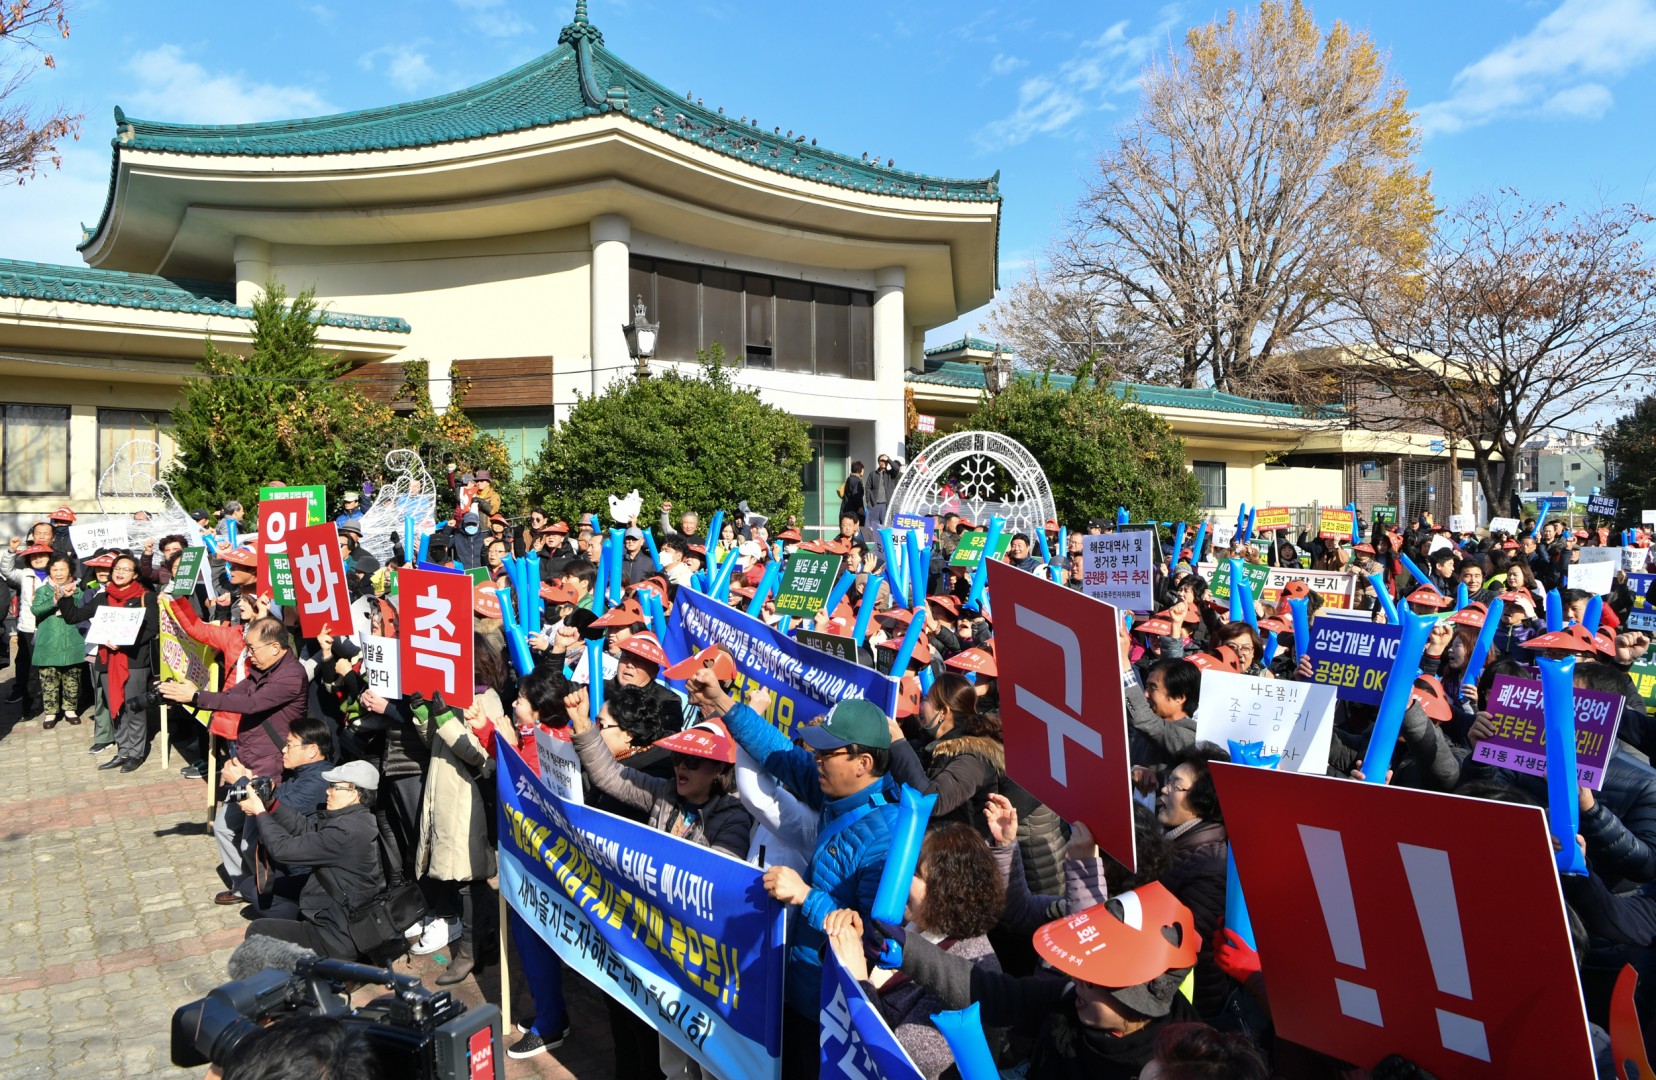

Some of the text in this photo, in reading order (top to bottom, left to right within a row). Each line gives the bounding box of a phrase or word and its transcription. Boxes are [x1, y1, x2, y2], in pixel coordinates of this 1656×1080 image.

[1090, 538, 1142, 554] 해운대역사 및
[1094, 554, 1138, 568] 정거장 부지
[794, 558, 829, 574] 빌딩 숲 속
[1084, 570, 1149, 586] 공원화 적극 추진
[295, 543, 339, 622] 화
[791, 576, 822, 592] 주민들의
[1314, 577, 1338, 590] 부지
[410, 585, 462, 694] 촉
[1316, 628, 1400, 660] 상업개발 NO
[1314, 660, 1388, 692] 공원화 OK
[1014, 602, 1104, 788] 구
[1479, 746, 1508, 763] 좌1동
[621, 846, 658, 898] 보내는
[660, 862, 714, 922] 메시지!!
[632, 900, 670, 958] 주민
[668, 916, 741, 1010] 품으로!!
[1296, 823, 1491, 1064] !!
